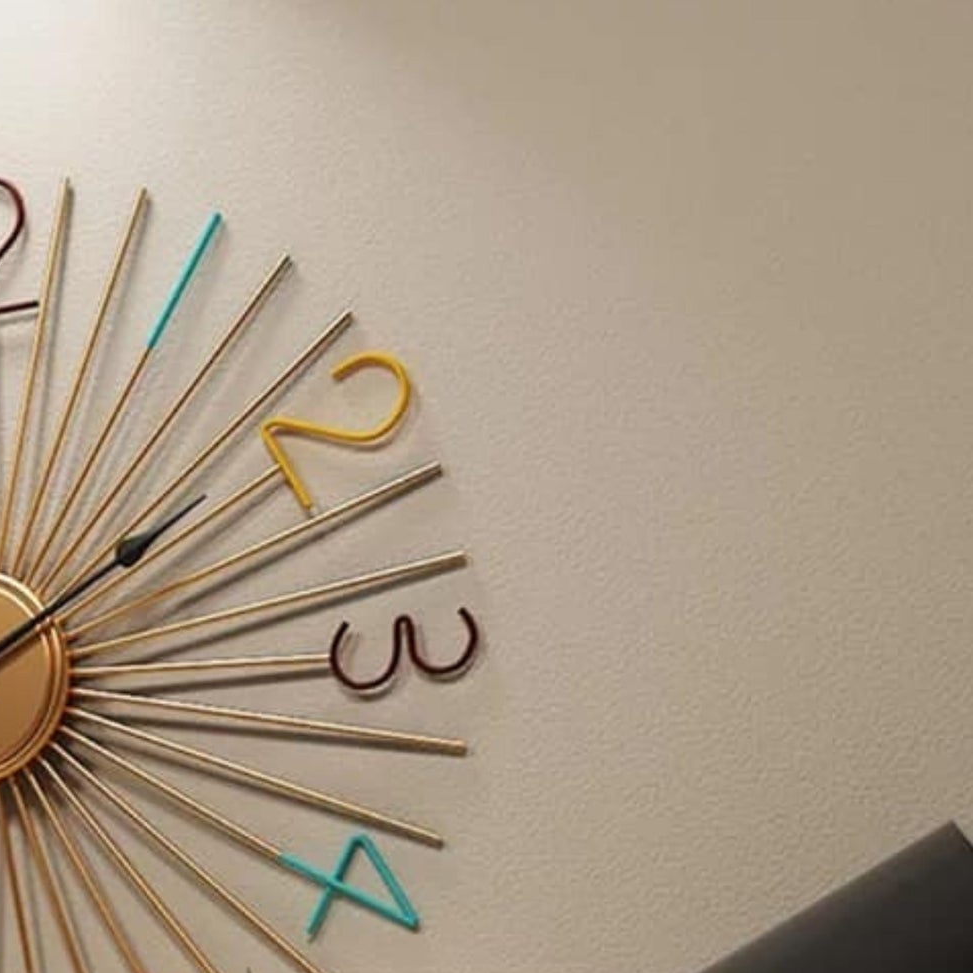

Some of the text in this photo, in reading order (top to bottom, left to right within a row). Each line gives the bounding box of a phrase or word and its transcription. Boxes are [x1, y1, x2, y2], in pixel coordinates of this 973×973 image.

[261, 352, 412, 512] 2
[329, 606, 480, 700] 3
[281, 834, 421, 940] 4
